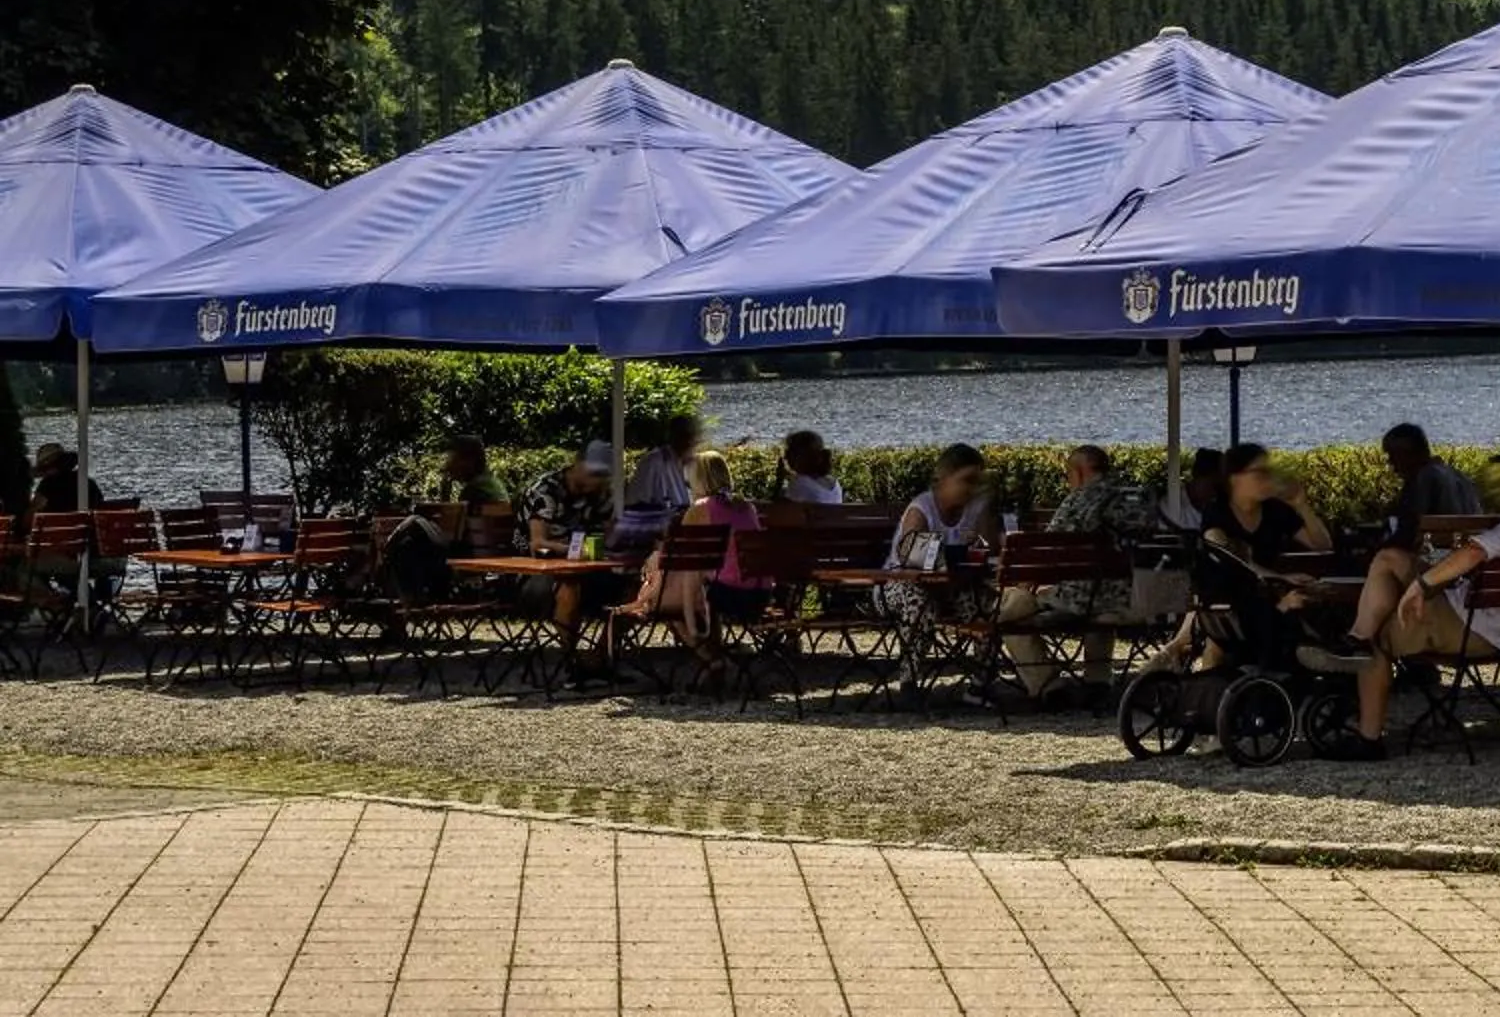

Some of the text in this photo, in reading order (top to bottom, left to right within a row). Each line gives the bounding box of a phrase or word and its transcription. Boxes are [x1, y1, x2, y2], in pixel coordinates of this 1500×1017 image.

[1169, 268, 1299, 318] Fürstenberg
[235, 300, 336, 337] Fürstenberg
[739, 296, 846, 340] Fürstenberg
